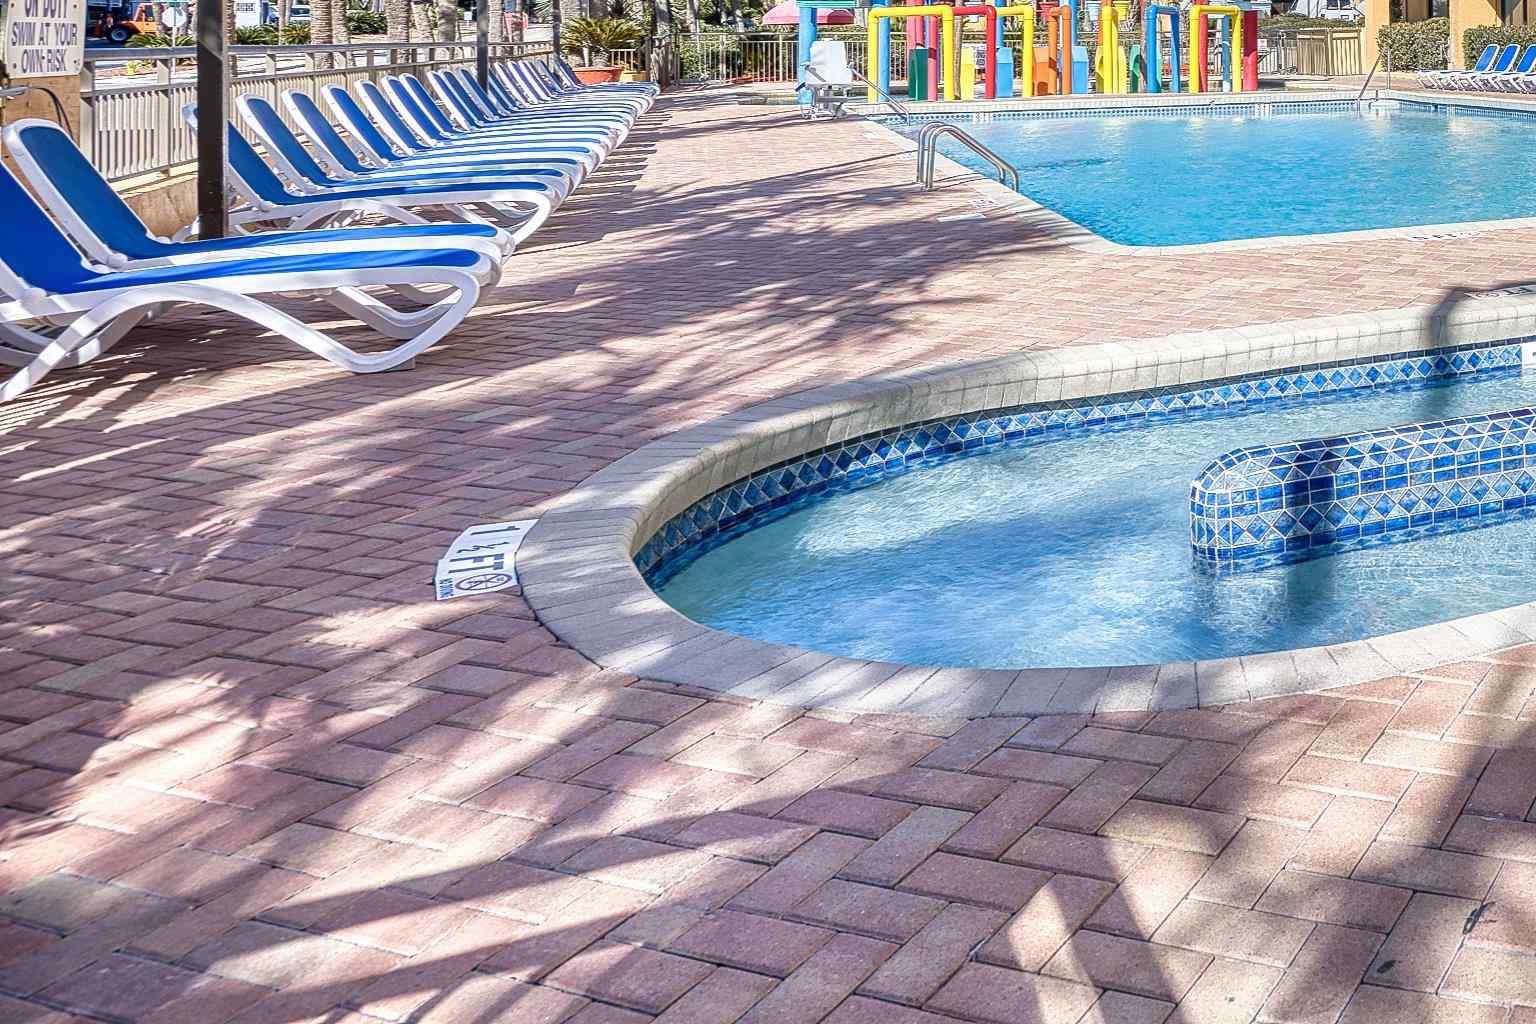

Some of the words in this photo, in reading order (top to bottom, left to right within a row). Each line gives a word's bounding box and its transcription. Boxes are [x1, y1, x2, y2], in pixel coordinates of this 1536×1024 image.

[11, 22, 36, 46] SWIM
[39, 23, 51, 46] AT
[54, 22, 78, 46] YOUR
[46, 48, 67, 73] RISK
[447, 553, 505, 574] FT
